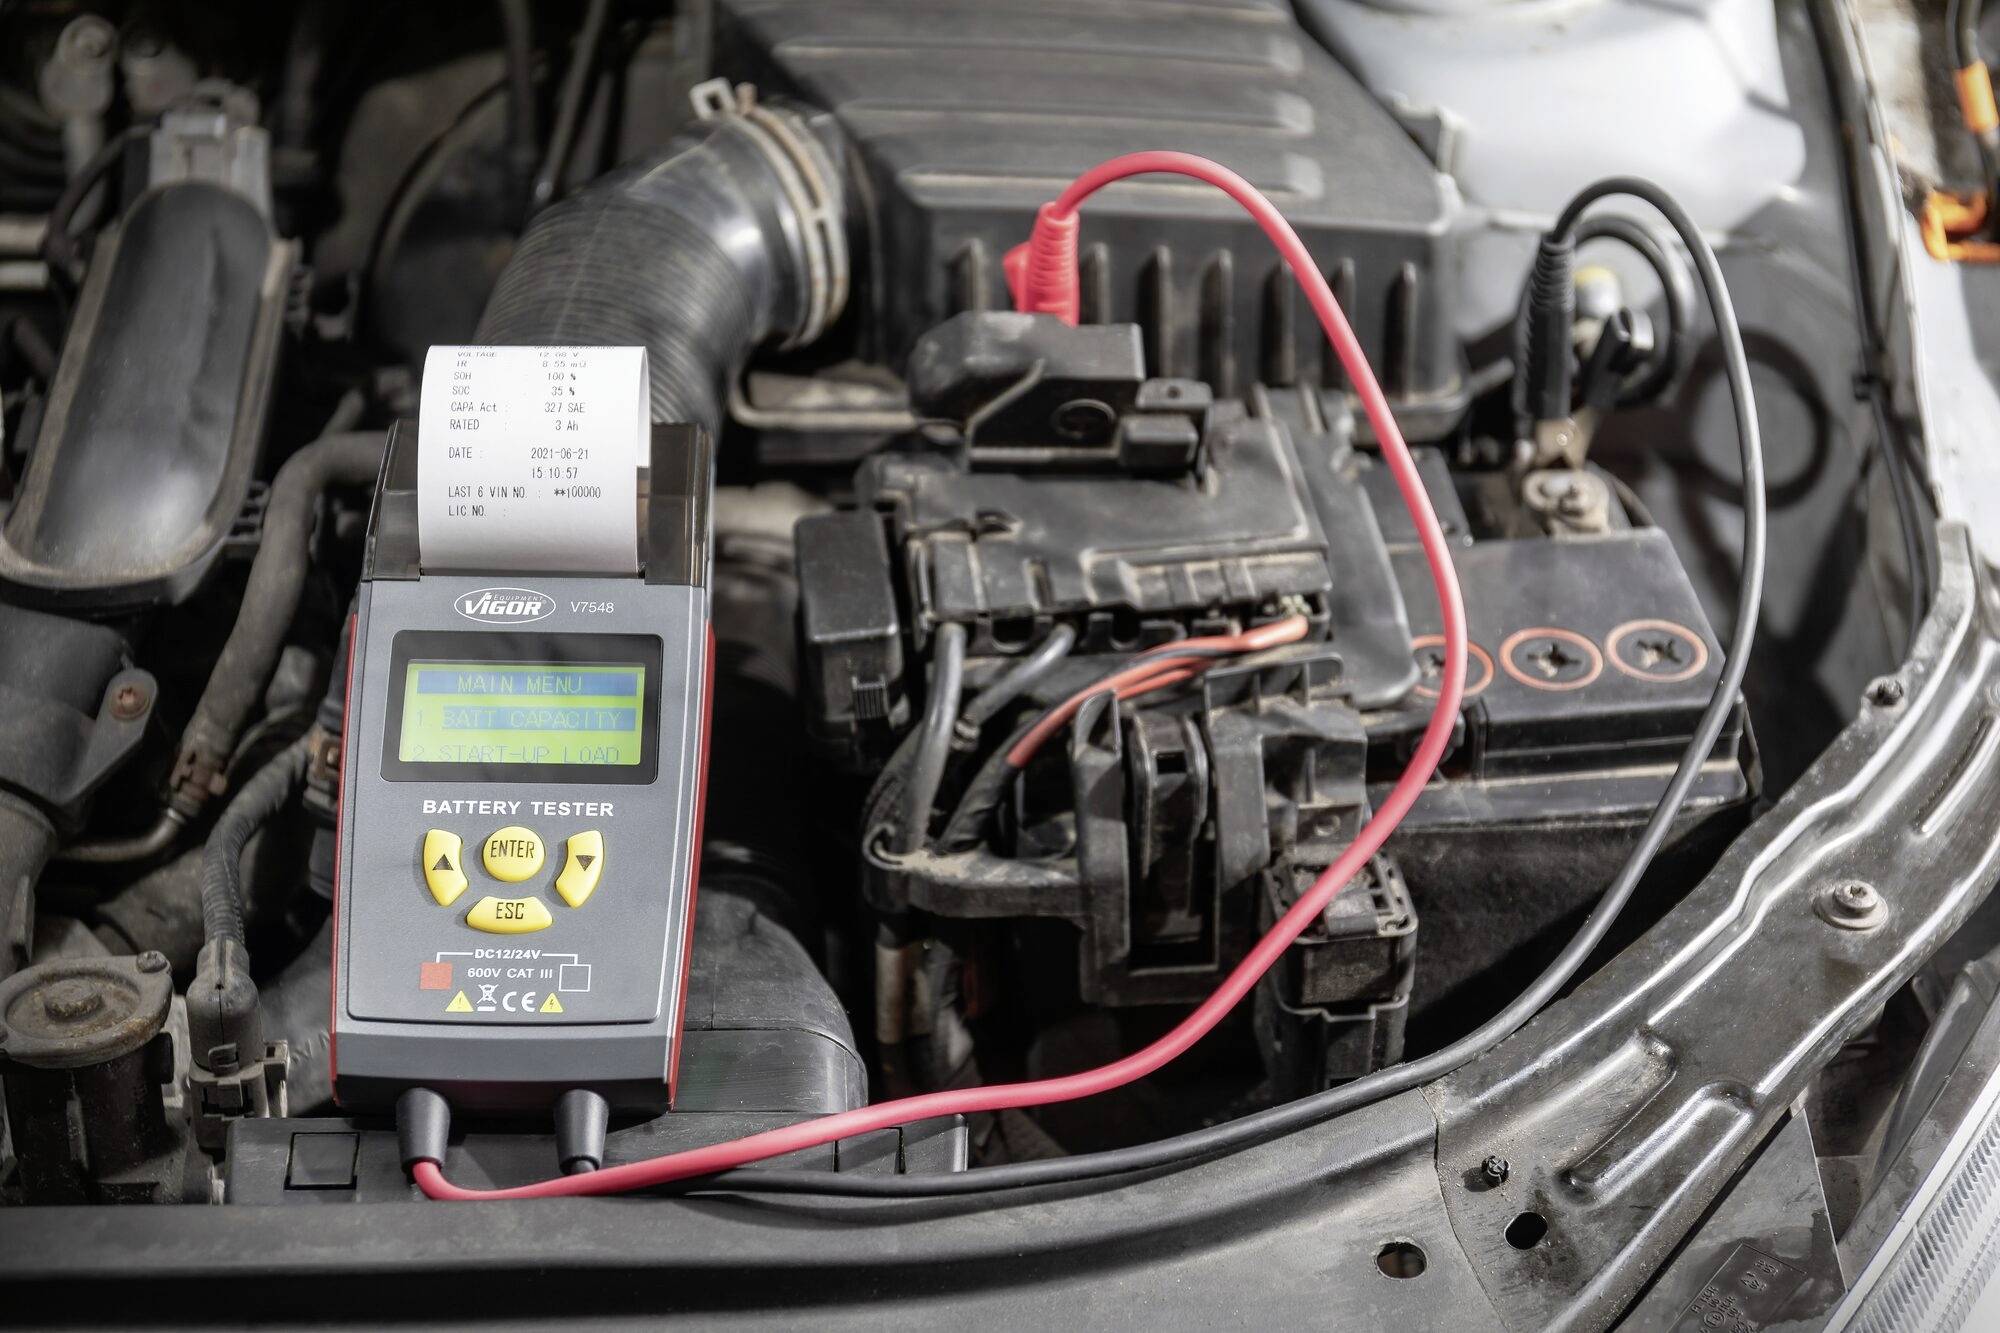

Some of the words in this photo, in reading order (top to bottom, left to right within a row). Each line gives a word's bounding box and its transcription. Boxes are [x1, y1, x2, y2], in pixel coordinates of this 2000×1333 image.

[453, 371, 472, 381] SOH
[547, 371, 565, 381] 100
[452, 385, 470, 395] SOC
[551, 385, 564, 396] 35
[544, 401, 563, 413] 327
[567, 402, 587, 413] SAE
[449, 418, 480, 430] RATED
[566, 419, 579, 431] Ah
[448, 446, 473, 459] DATE
[531, 447, 588, 459] 2021-06-21
[448, 485, 471, 498] LAST
[477, 485, 484, 498] 6
[489, 486, 508, 498] VIN
[465, 593, 541, 615] VIGOR
[571, 601, 614, 613] V7548
[458, 675, 513, 693] MAIN
[526, 675, 582, 694] MENU
[442, 710, 497, 728] BATT
[510, 711, 623, 729] CAPACITY
[439, 745, 550, 763] START-UP
[563, 746, 620, 764] LOAD
[422, 800, 522, 815] BATTERY
[531, 801, 614, 817] TESTER
[490, 839, 535, 859] ENTER
[496, 902, 525, 920] ESC
[474, 948, 541, 960] DC12/24V
[467, 968, 501, 978] 600V
[507, 968, 534, 978] CAT
[540, 968, 552, 978] III
[502, 991, 536, 1012] CE
